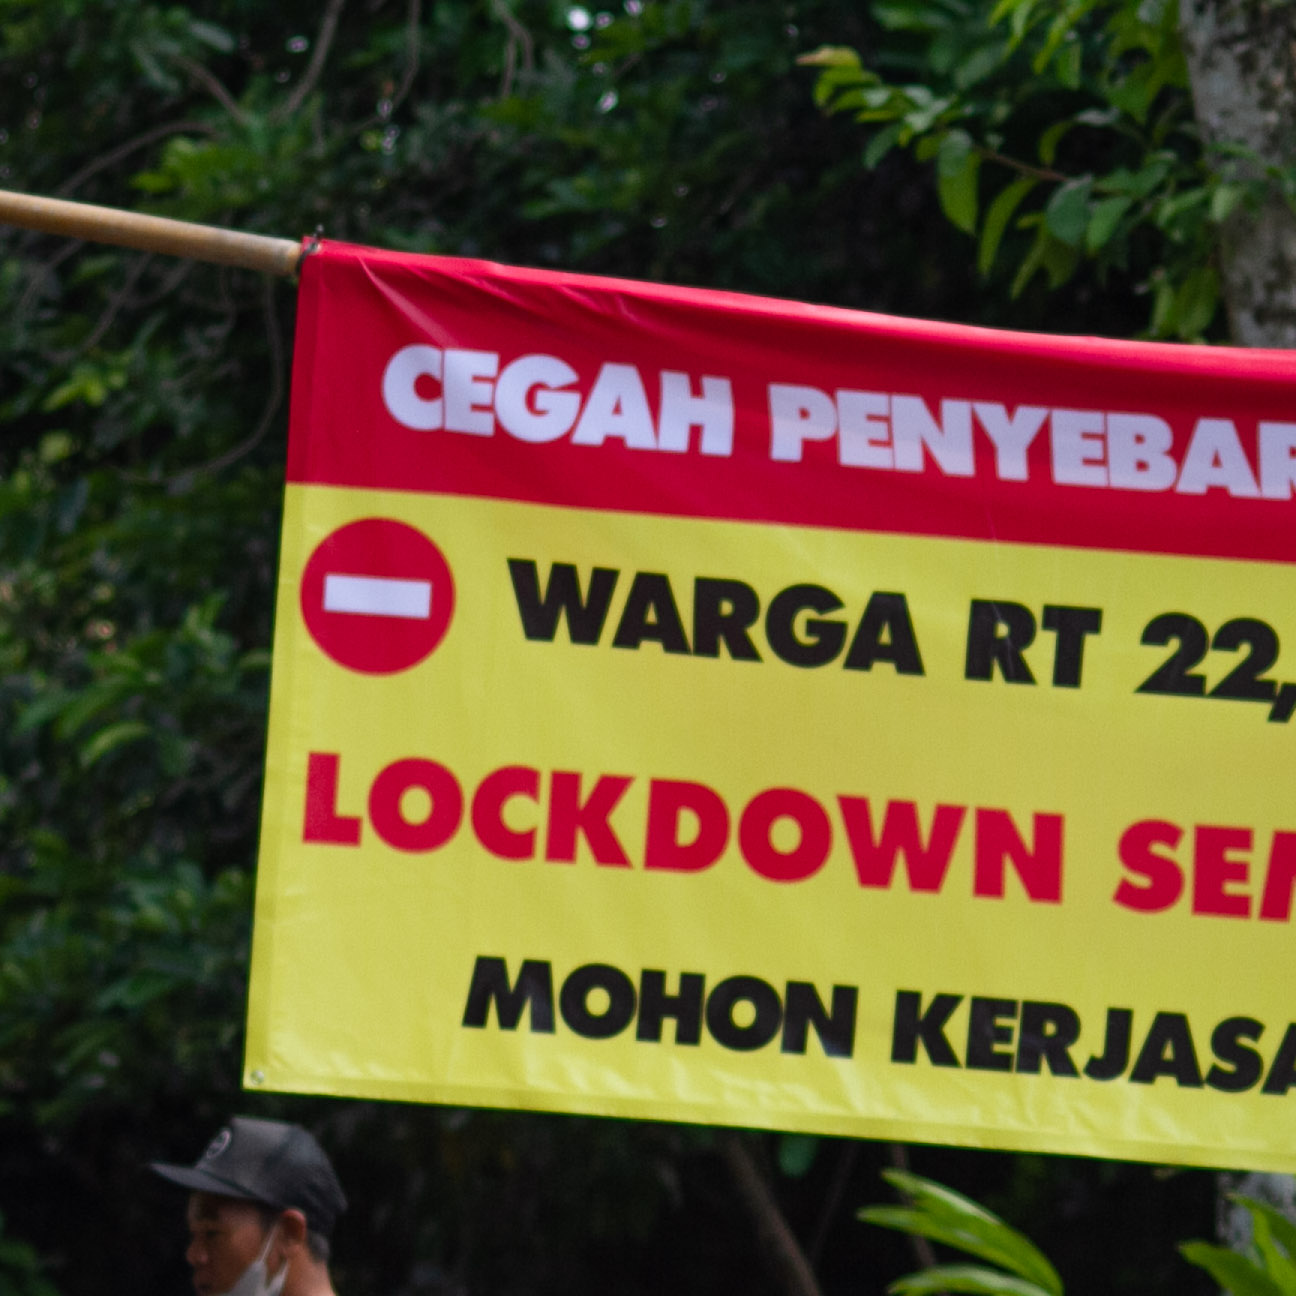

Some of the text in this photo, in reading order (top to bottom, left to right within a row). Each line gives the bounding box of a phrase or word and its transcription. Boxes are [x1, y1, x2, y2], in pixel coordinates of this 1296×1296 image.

[382, 345, 734, 456] CEGAH
[507, 558, 925, 677] WARGA
[964, 599, 1103, 688] RT
[303, 752, 1062, 903] LOCKDOWN
[461, 955, 859, 1058] MOHON
